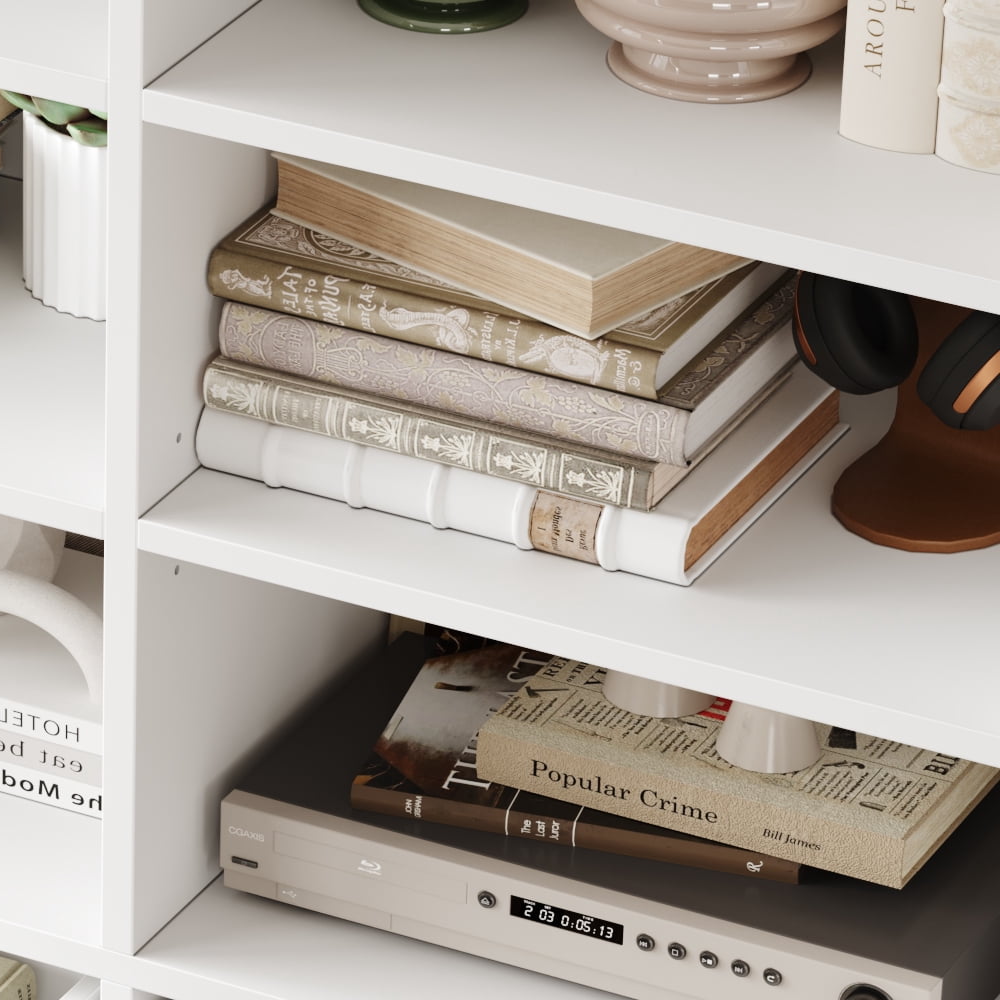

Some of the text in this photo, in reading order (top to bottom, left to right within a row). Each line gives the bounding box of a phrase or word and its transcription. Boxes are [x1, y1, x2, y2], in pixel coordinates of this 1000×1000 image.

[530, 758, 718, 825] Popular Crime
[520, 819, 532, 834] The
[535, 820, 546, 837] Last
[549, 819, 561, 841] Juror
[762, 828, 822, 852] Bill James
[524, 905, 614, 940] 2 03 0:05:13
